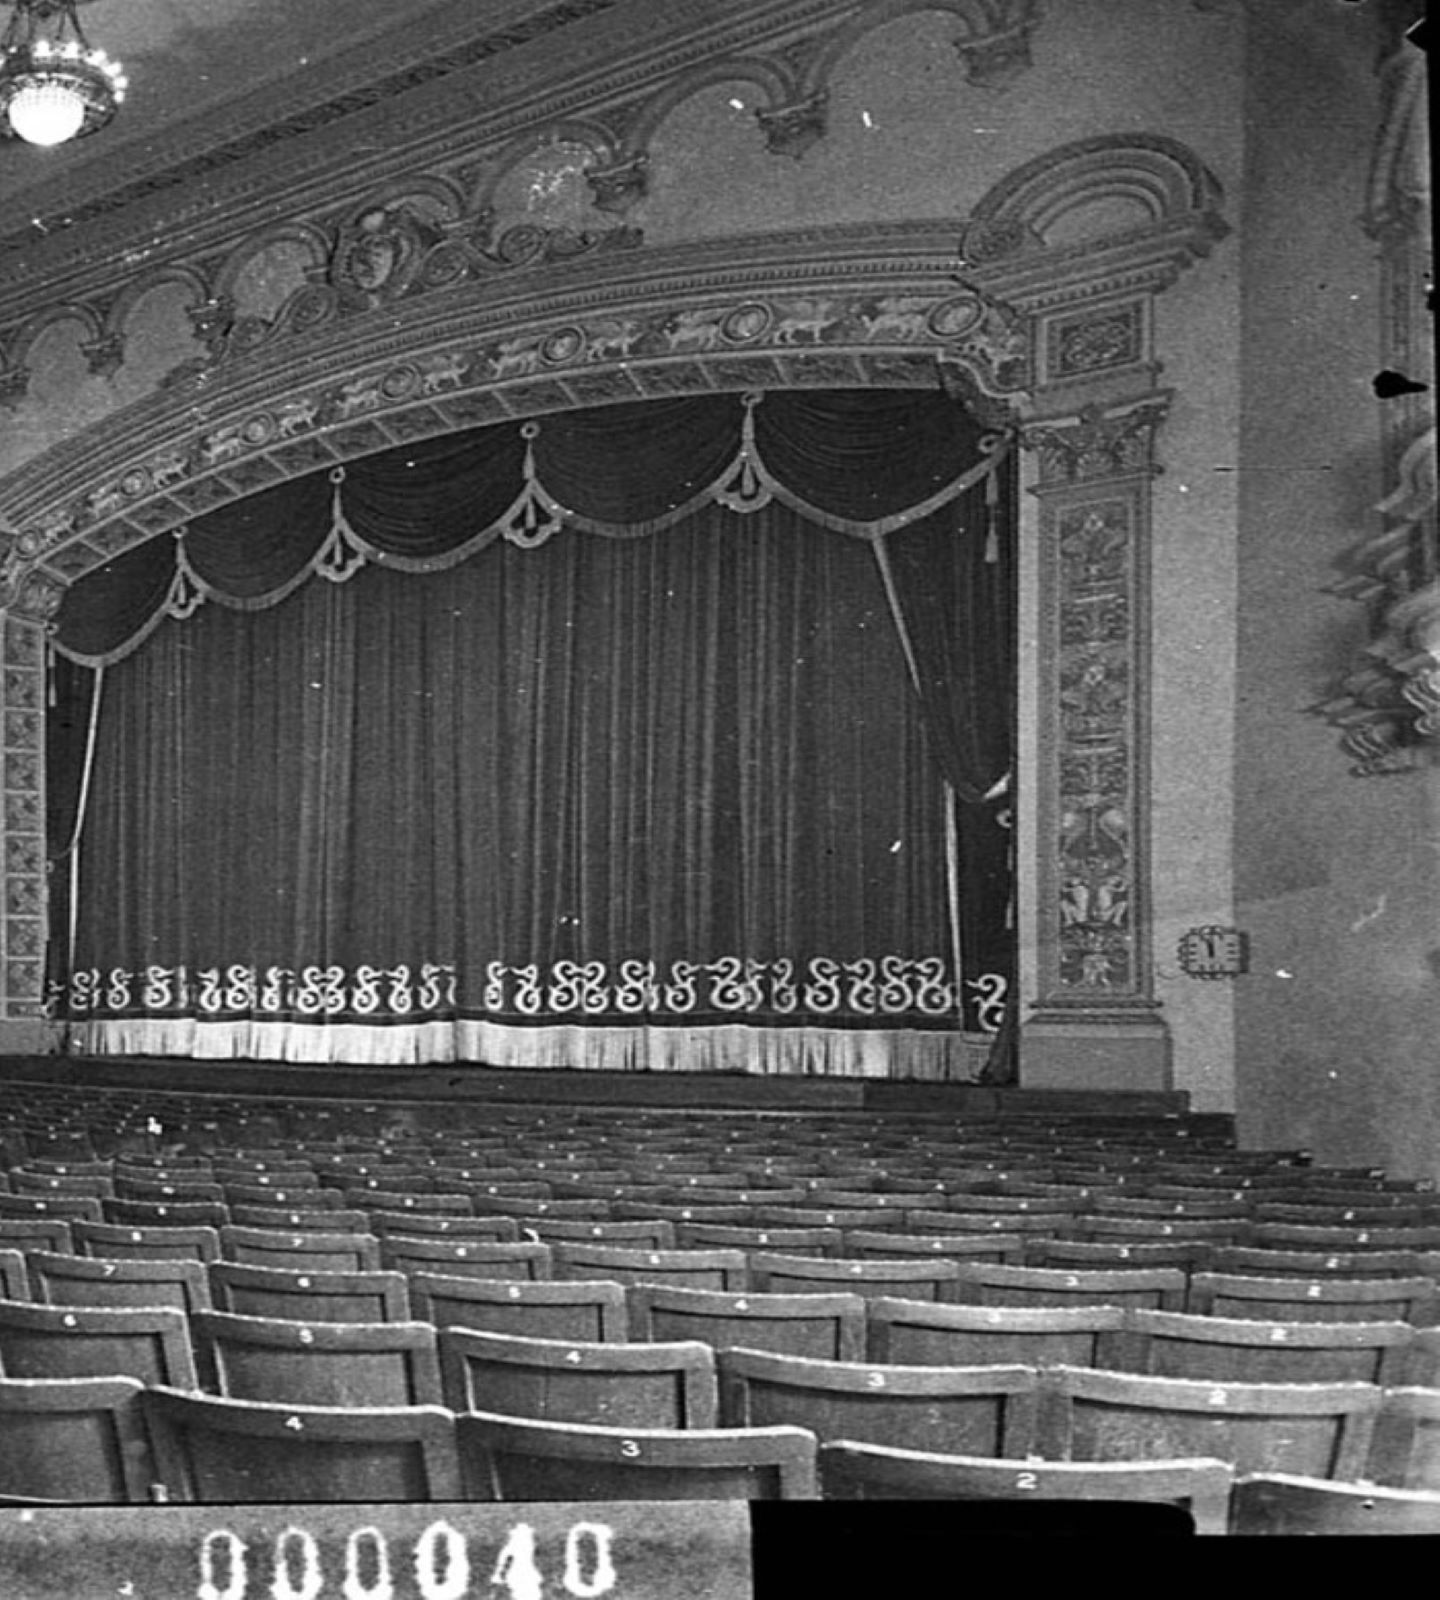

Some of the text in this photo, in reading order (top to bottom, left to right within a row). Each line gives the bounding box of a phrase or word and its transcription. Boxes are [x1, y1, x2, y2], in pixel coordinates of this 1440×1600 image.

[291, 1235, 304, 1247] 7
[103, 1264, 116, 1276] 7
[1065, 1275, 1080, 1287] 3
[734, 1299, 749, 1310] 4
[566, 1350, 581, 1364] 4
[867, 1371, 886, 1388] 3
[1207, 1387, 1228, 1405] 2
[285, 1415, 303, 1431] 4
[621, 1440, 641, 1457] 3
[1016, 1472, 1037, 1490] 2
